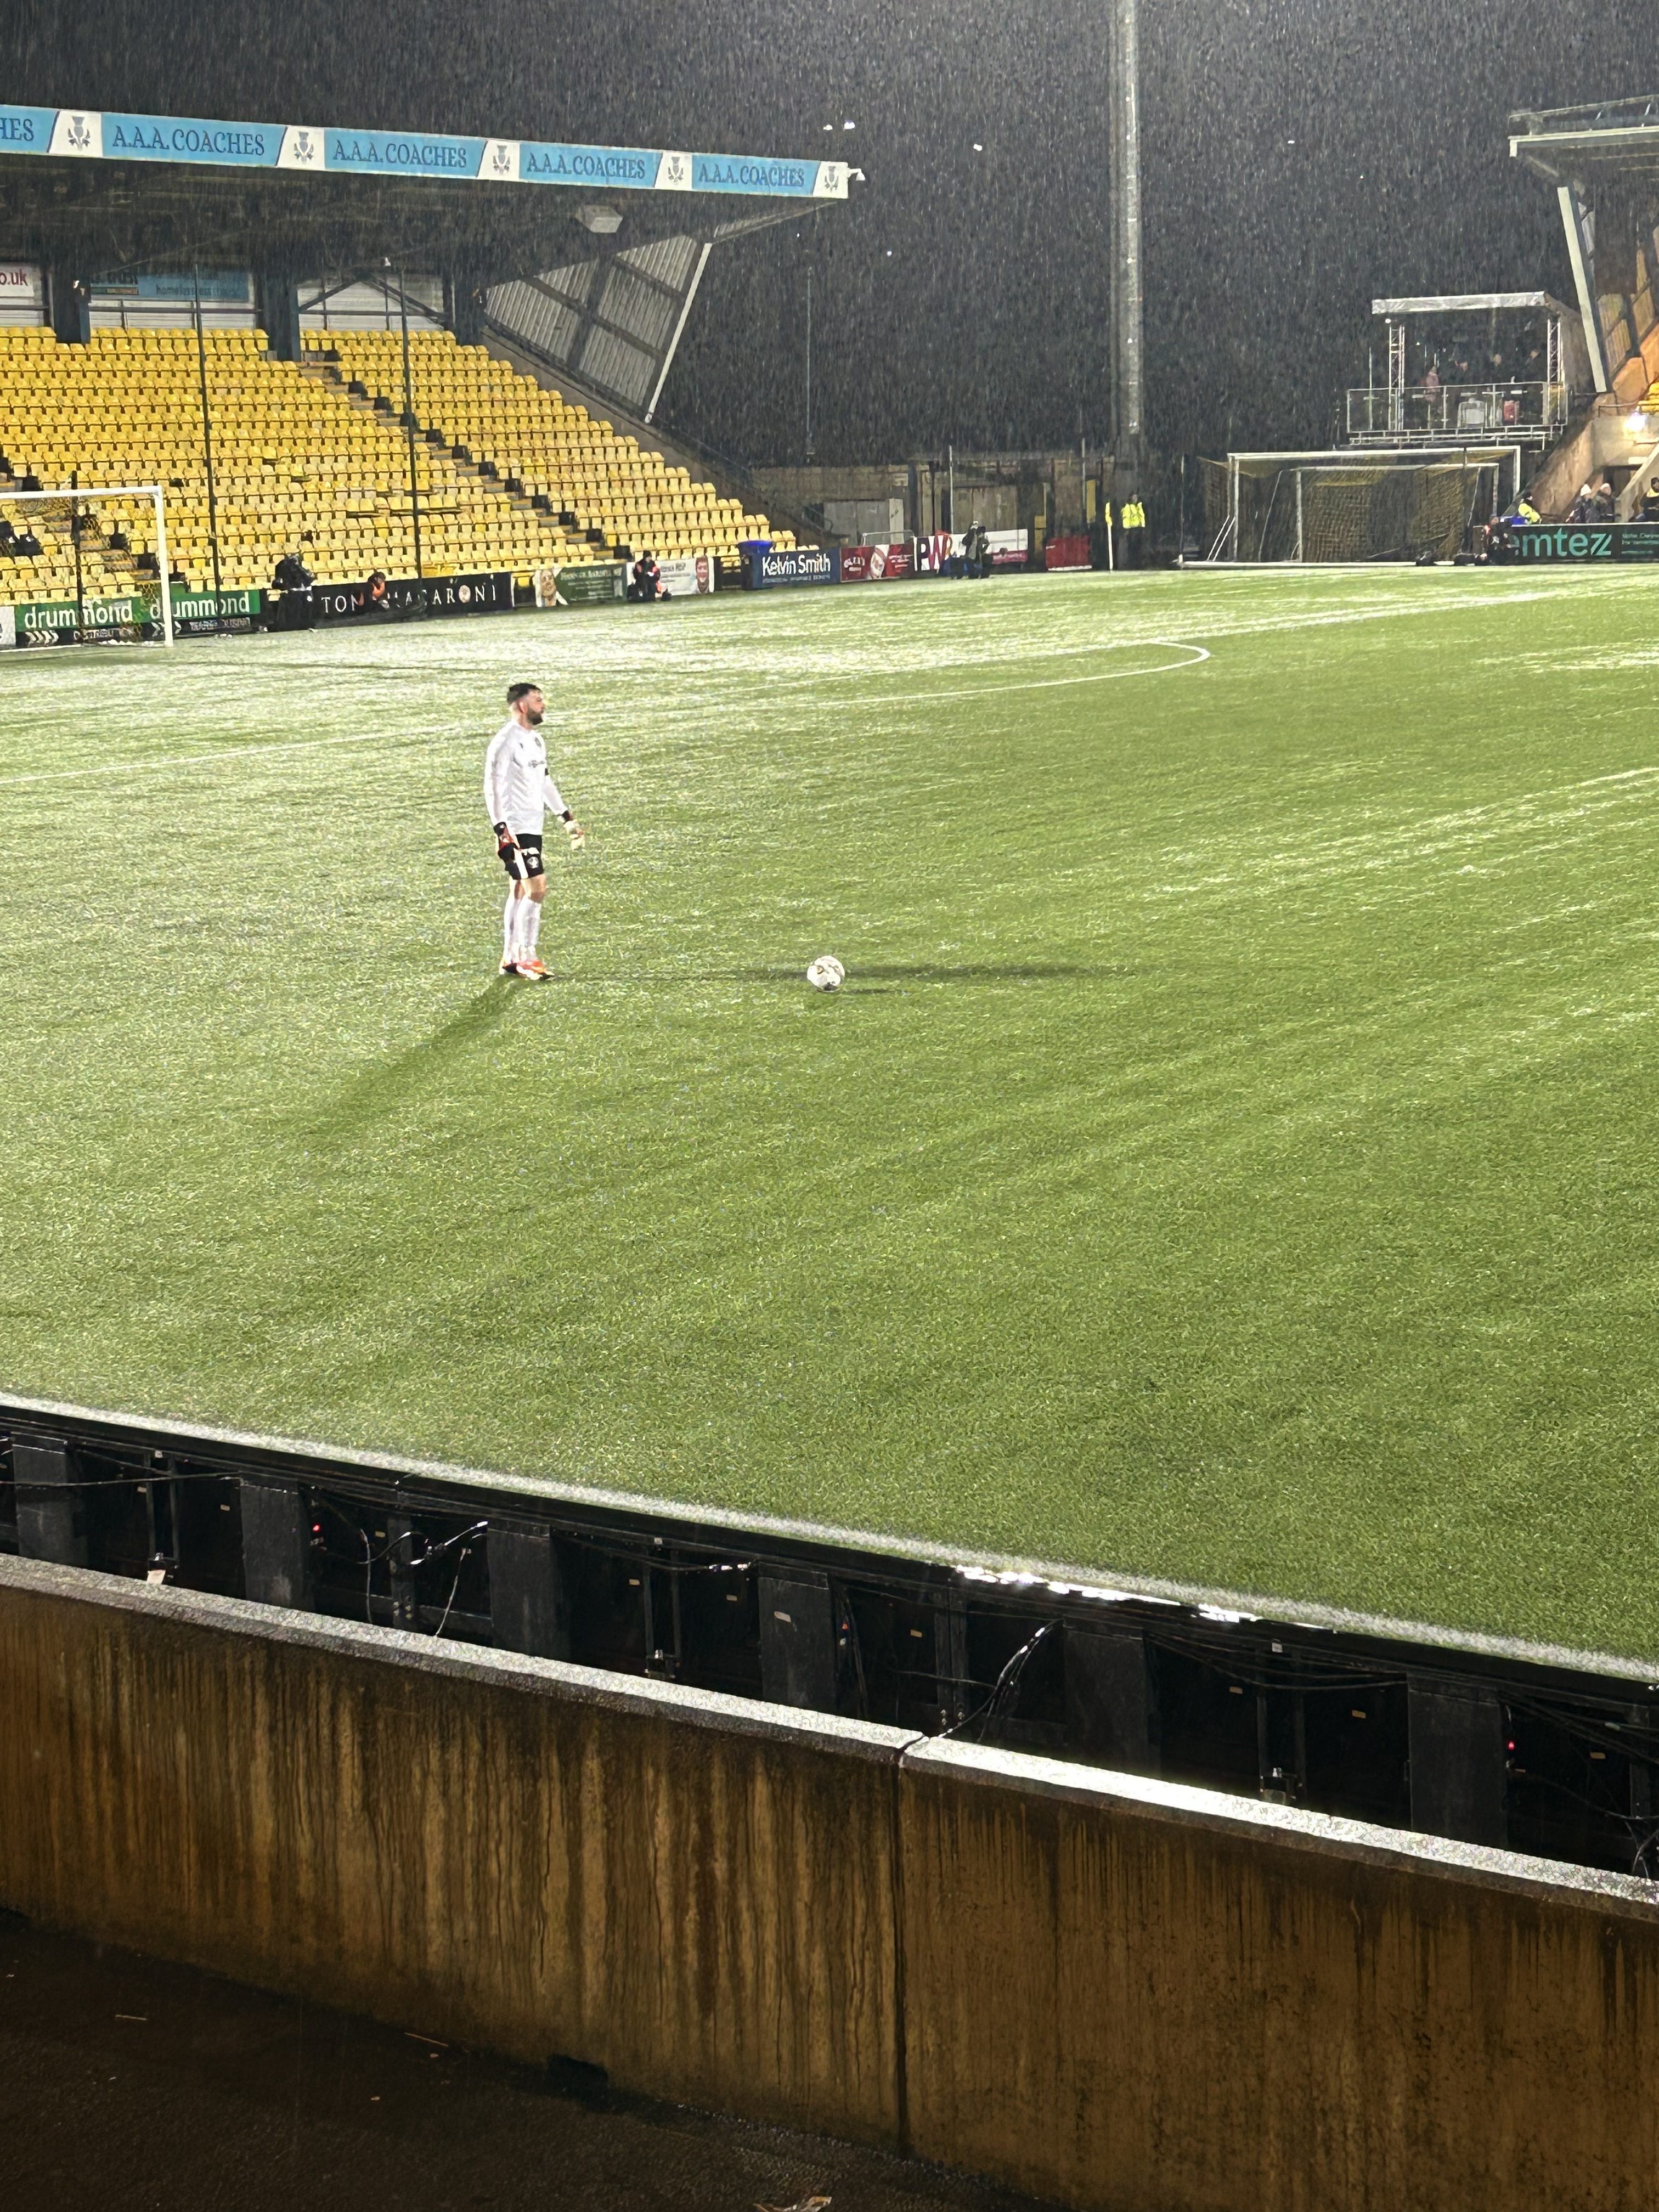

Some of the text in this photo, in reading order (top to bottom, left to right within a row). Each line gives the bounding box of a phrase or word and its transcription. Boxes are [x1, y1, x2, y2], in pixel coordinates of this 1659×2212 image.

[172, 128, 264, 156] COACHES
[386, 143, 467, 167] COACHES
[573, 155, 645, 179] COACHES
[740, 166, 804, 187] COACHES
[763, 555, 797, 576] Kelvin
[798, 553, 831, 574] Smith
[150, 591, 250, 619] dummond
[320, 585, 496, 613] TON AARONI
[24, 600, 133, 628] drummond
